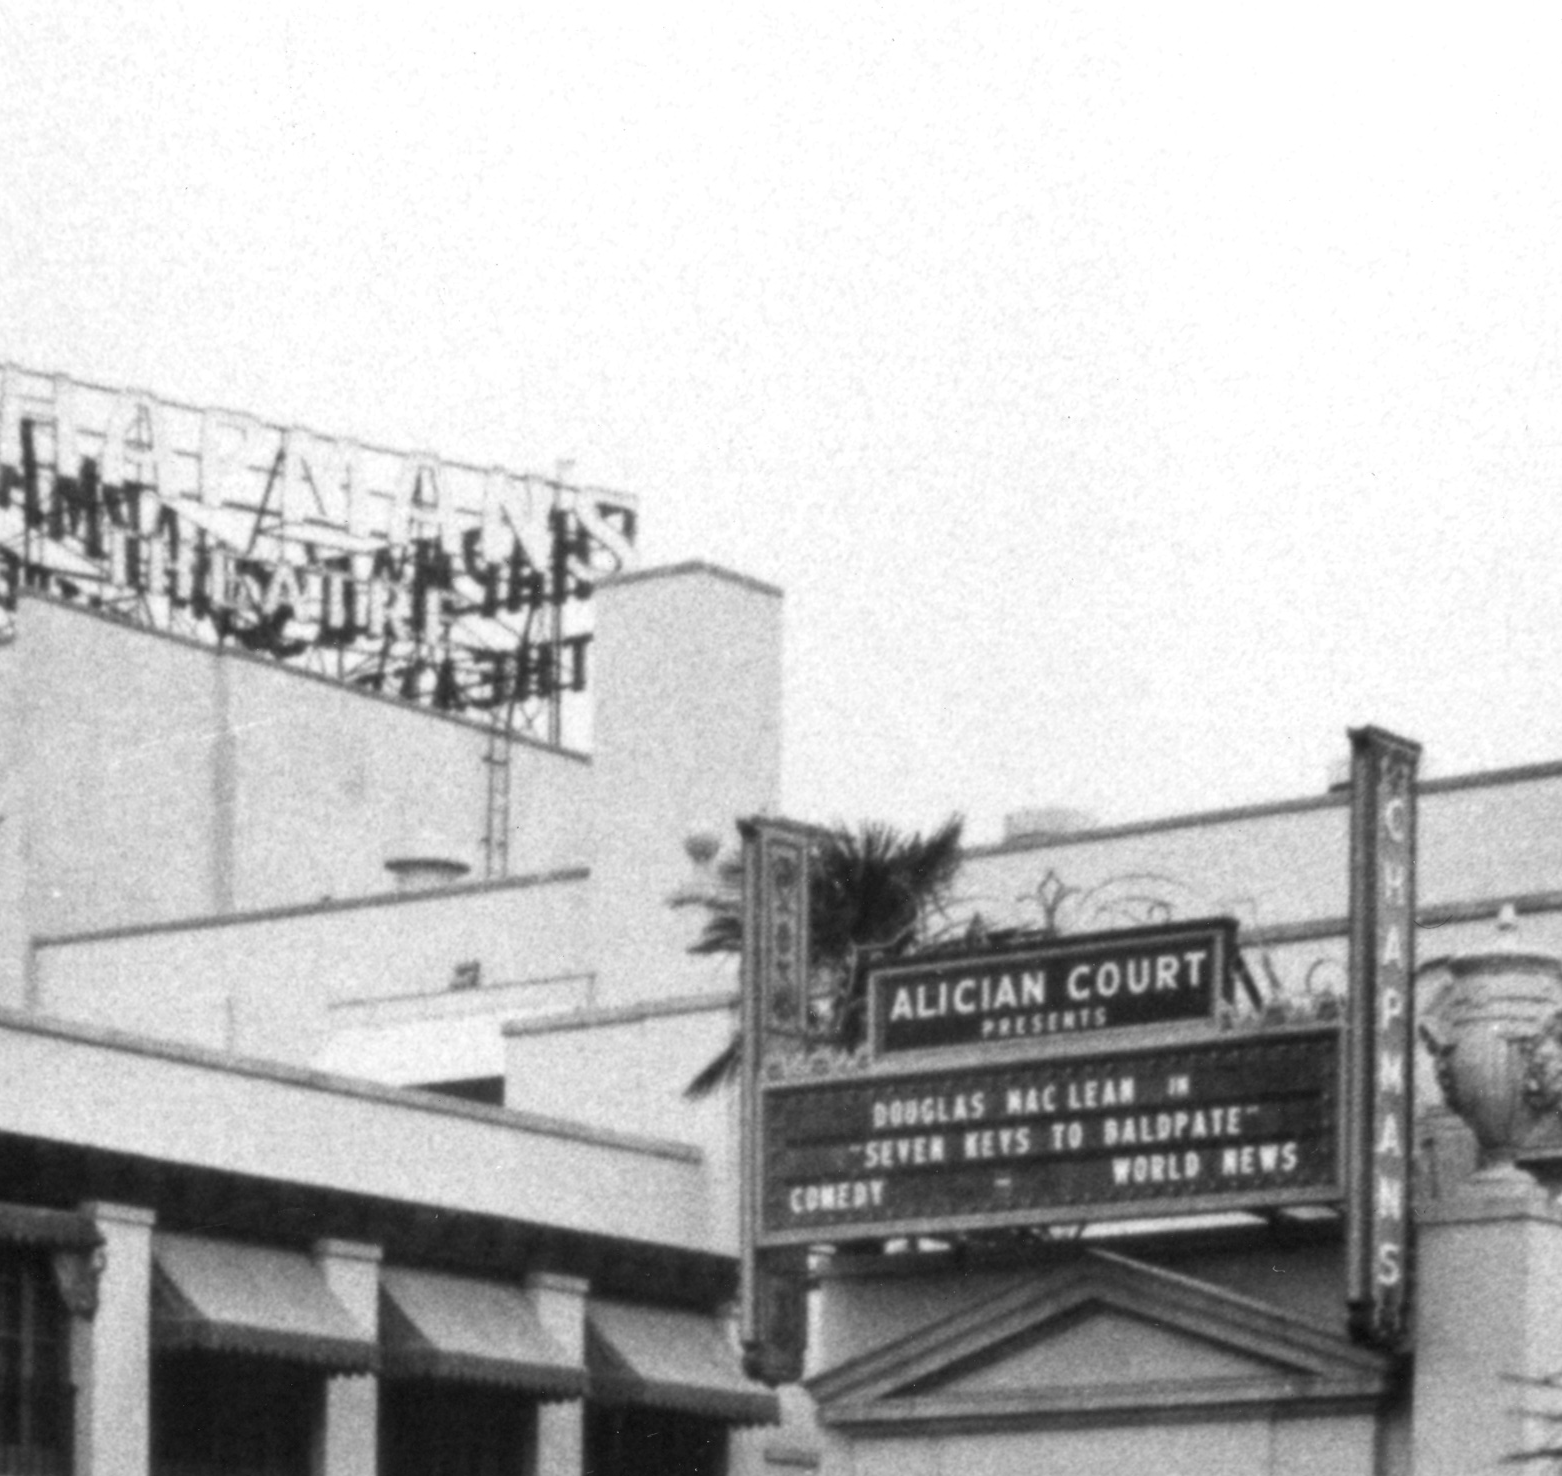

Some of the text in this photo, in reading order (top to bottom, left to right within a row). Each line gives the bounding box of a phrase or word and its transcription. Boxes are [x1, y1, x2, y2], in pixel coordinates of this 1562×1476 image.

[889, 950, 1206, 1022] ALICIAN COURT
[982, 1006, 1107, 1039] PRESENTS
[1375, 799, 1407, 1285] CHAPMANS
[872, 1089, 986, 1129] DOUGLAS
[1167, 1074, 1190, 1097] IN
[963, 1126, 1031, 1160] KEYS
[1051, 1121, 1084, 1152] TO
[1112, 1142, 1298, 1185] WORLD NEWS
[788, 1177, 886, 1215] COMEDY
